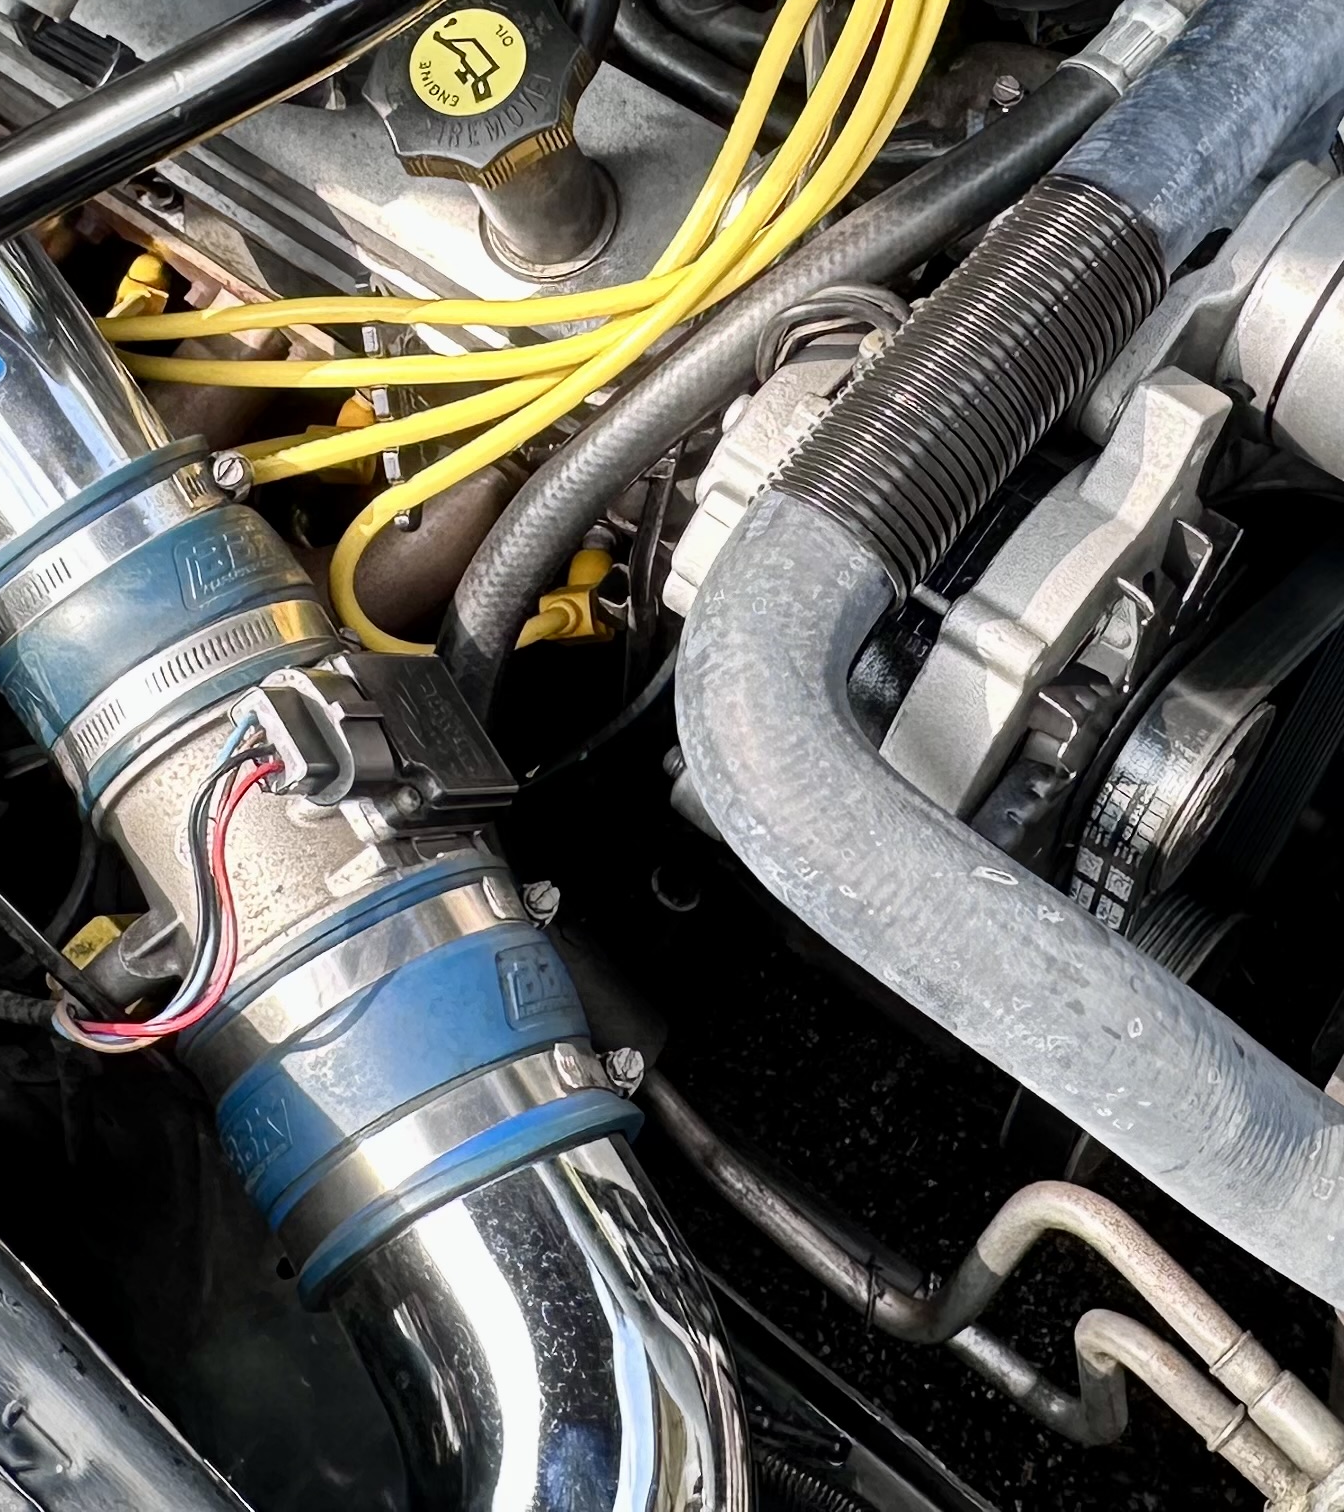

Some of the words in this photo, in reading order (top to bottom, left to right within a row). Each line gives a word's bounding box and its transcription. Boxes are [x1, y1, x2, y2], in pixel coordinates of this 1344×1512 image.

[494, 23, 515, 48] OIL
[418, 59, 460, 108] ENGINE
[436, 74, 553, 150] REMOVE
